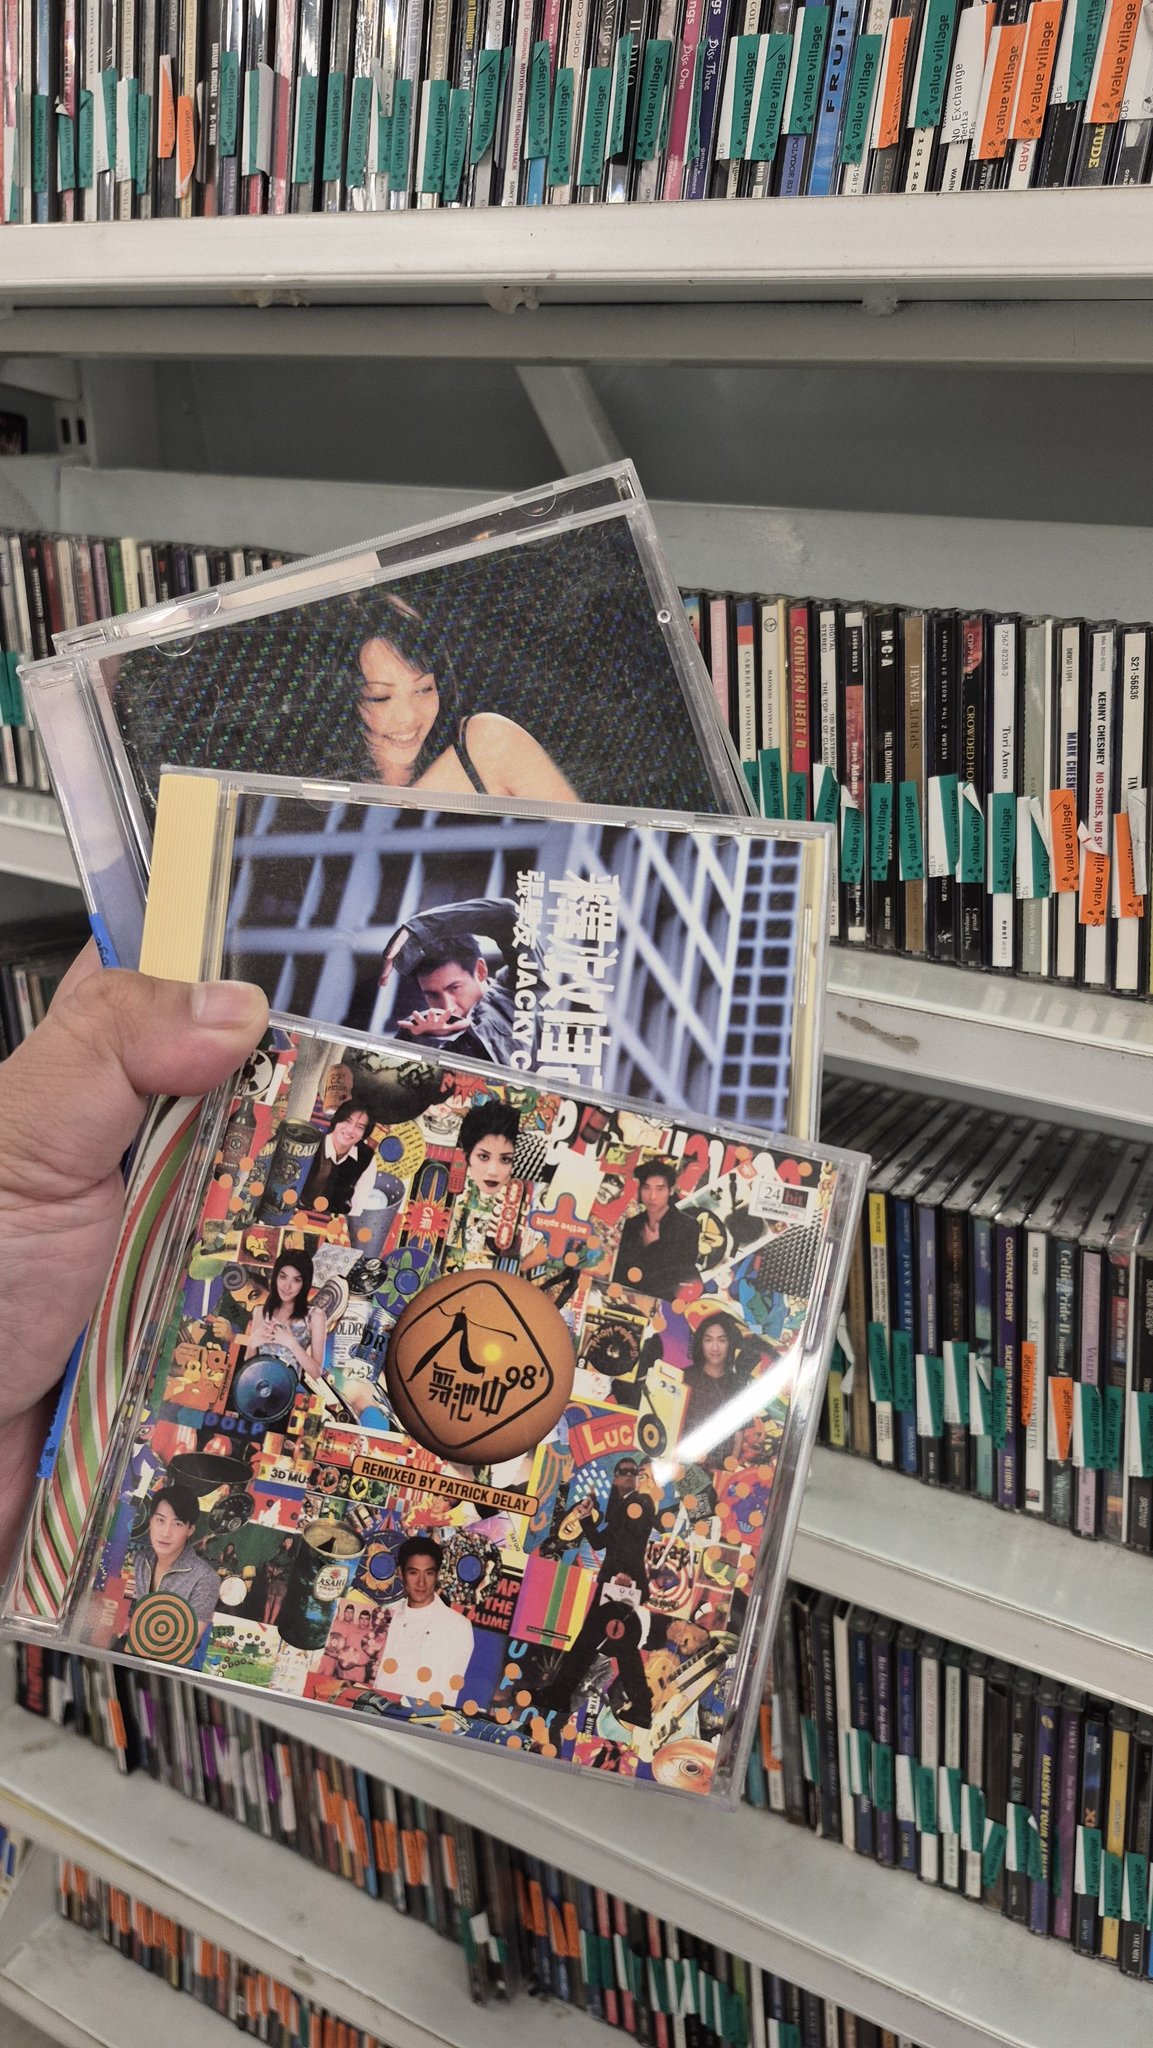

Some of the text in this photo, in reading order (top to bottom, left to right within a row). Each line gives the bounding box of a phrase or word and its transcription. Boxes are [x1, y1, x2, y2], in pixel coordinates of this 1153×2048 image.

[572, 21, 583, 58] racine
[1086, 0, 1100, 32] villa
[211, 43, 219, 64] DRUM
[679, 44, 693, 90] Disc One
[703, 38, 719, 91] Disc Three
[803, 25, 822, 112] value village
[825, 6, 850, 113] FRUIT
[929, 14, 949, 104] value village
[1031, 21, 1054, 114] value village
[1110, 3, 1137, 97] value village
[210, 67, 218, 98] CIRCLE
[481, 66, 496, 143] value village
[518, 63, 527, 93] MOTION
[538, 57, 549, 136] value village
[644, 56, 663, 139] value village
[741, 52, 756, 135] value village
[766, 54, 786, 140] value village
[851, 52, 874, 140] value village
[952, 63, 966, 143] No Exchange
[996, 46, 1019, 135] value village
[304, 91, 315, 164] value village
[354, 92, 368, 166] value village
[396, 96, 406, 170] value village
[433, 96, 447, 175] value village
[515, 95, 524, 124] PICTURE
[559, 85, 570, 164] value village
[591, 85, 607, 165] value village
[451, 106, 466, 180] value village
[512, 124, 521, 171] SOUNDTRACK
[828, 623, 836, 652] DIGITAL
[1000, 629, 1009, 677] 7567-82358-2
[743, 651, 753, 750] CARRERAS DOMINGO
[793, 625, 808, 750] COUNTRY HEAT 4
[1129, 655, 1141, 700] S21-56836
[909, 664, 920, 749] JEWEL SPIRIT
[965, 705, 976, 760] CROWDED
[884, 732, 893, 785] NEIL DIAMOND
[1002, 726, 1012, 780] Tori Amos
[1066, 732, 1078, 757] MARK
[1093, 691, 1108, 834] KENNY CHESNEY NO SHOES, NO
[851, 764, 861, 795] Adams
[852, 811, 861, 836] villa
[876, 796, 889, 864] value village
[905, 796, 919, 862] value village
[1001, 808, 1012, 875] value village
[1062, 803, 1076, 872] value village
[512, 868, 546, 951] 張學友
[1092, 877, 1104, 907] value
[513, 952, 539, 1044] JACKY
[763, 1186, 804, 1207] 24 bit
[535, 1216, 588, 1235] active spirit
[1004, 1236, 1014, 1291] CONSTANCE
[1059, 1249, 1072, 1281] Celtic
[1004, 1292, 1014, 1322] DEMBY
[1058, 1286, 1071, 1321] Pride
[1085, 1346, 1098, 1380] VALLEY
[270, 1467, 289, 1482] 3D
[361, 1461, 530, 1512] REMIXED BY PATRICK DELAY
[317, 1576, 347, 1590] ASAHI
[485, 1598, 515, 1617] THE
[1040, 1754, 1052, 1807] MASSIVE
[1040, 1809, 1050, 1838] TOUR
